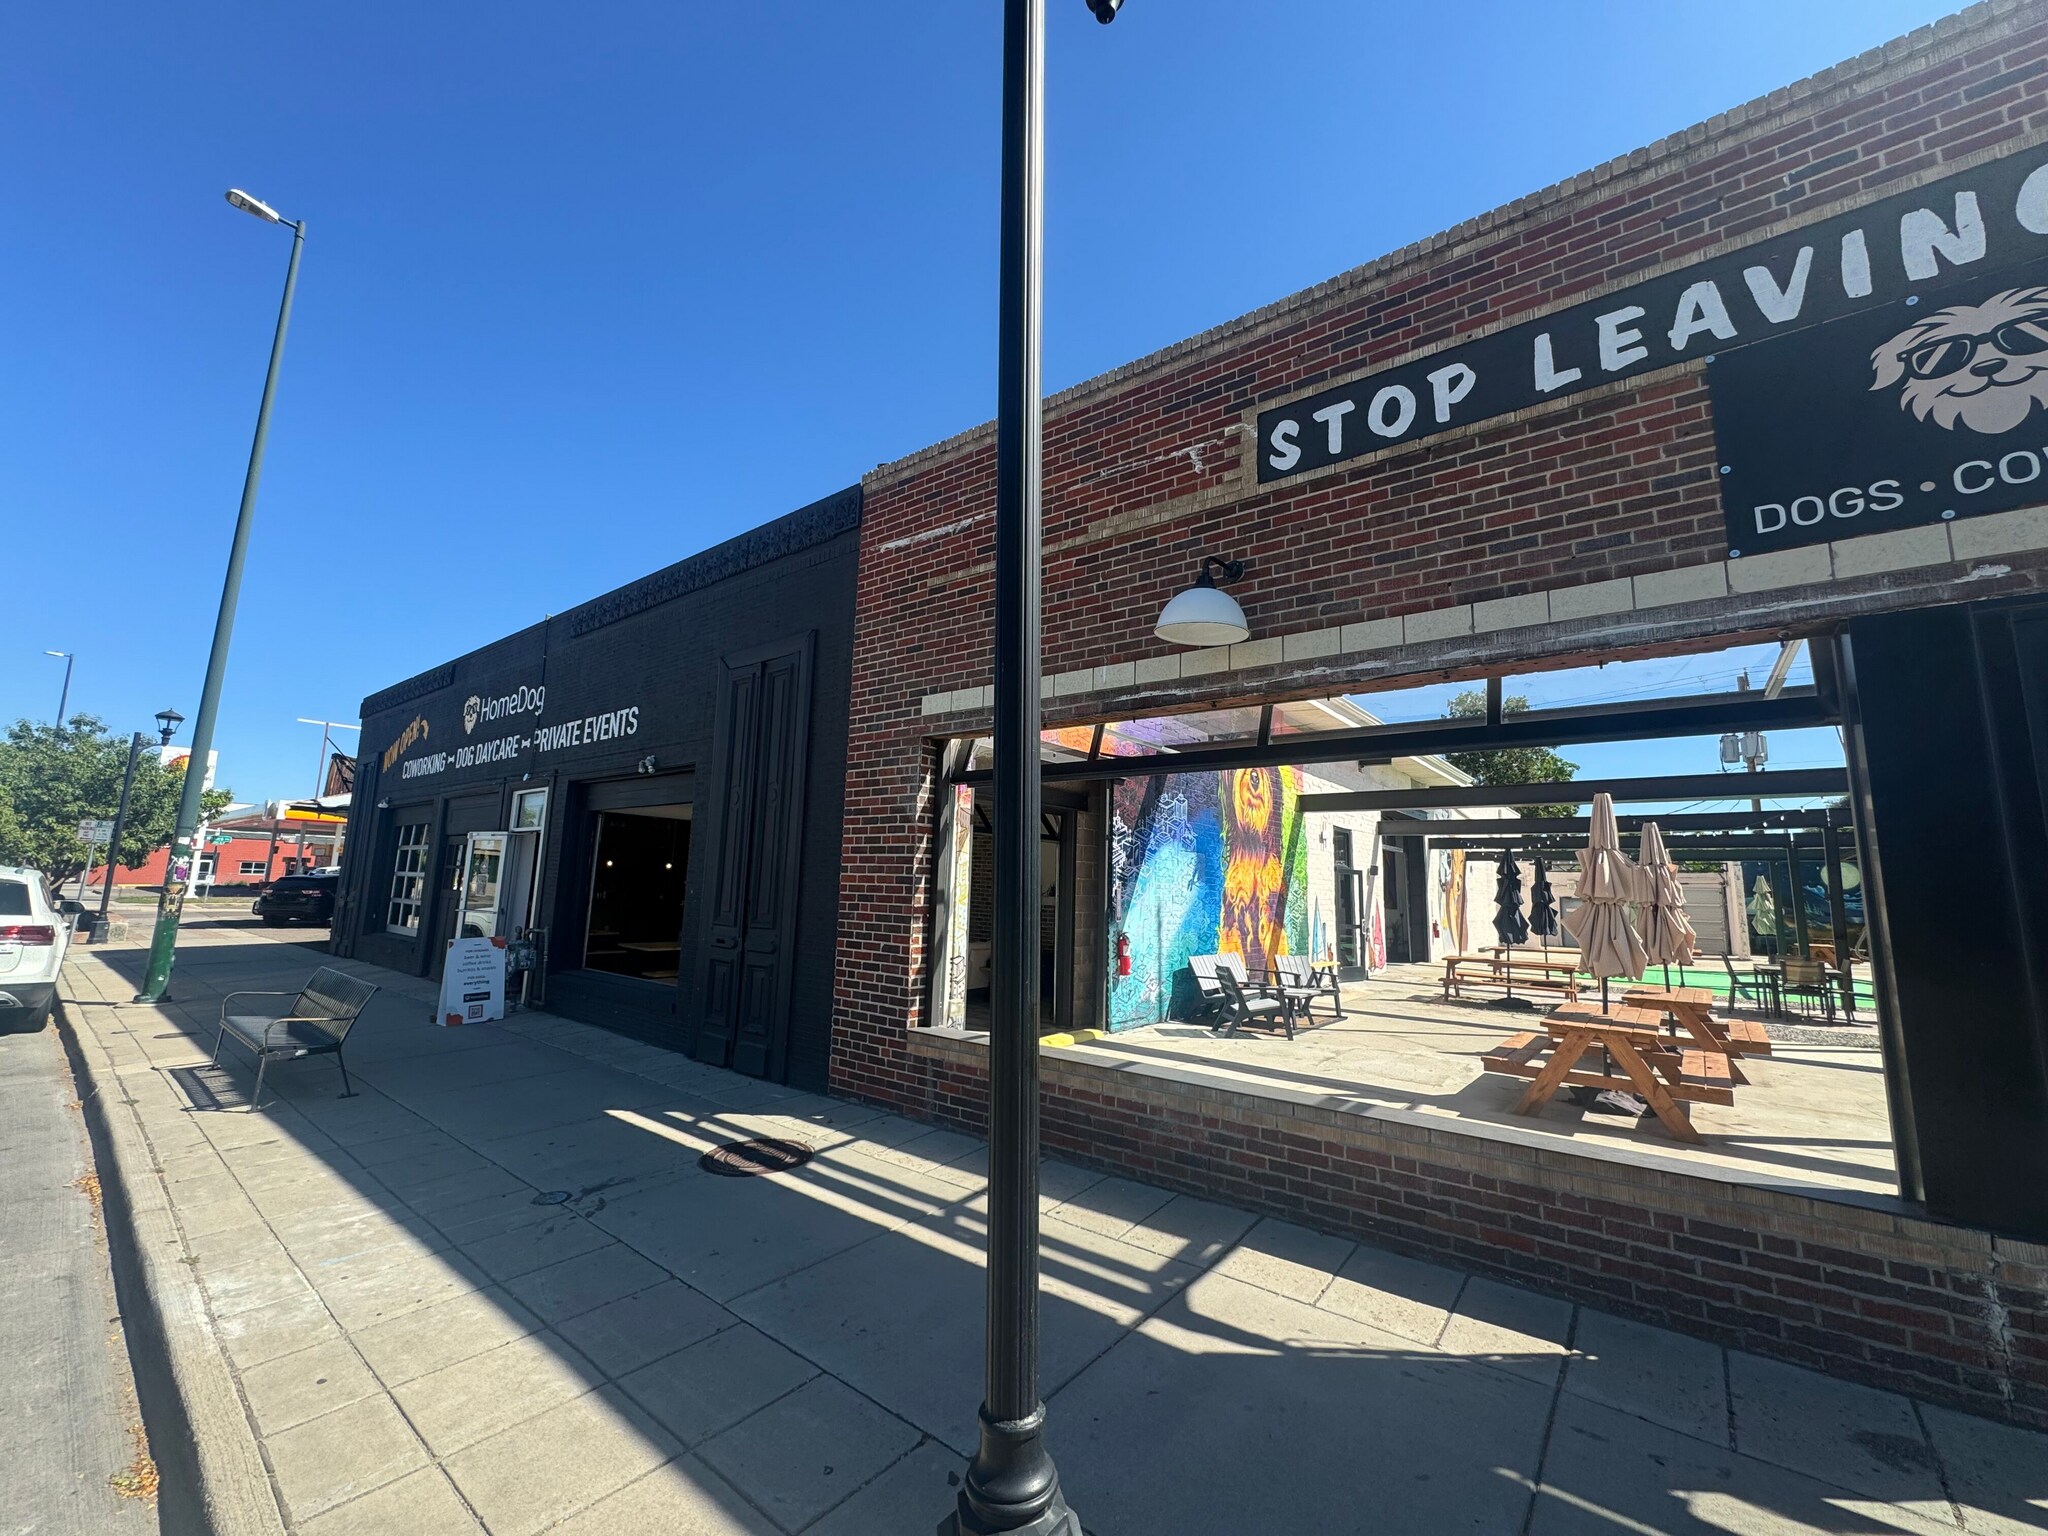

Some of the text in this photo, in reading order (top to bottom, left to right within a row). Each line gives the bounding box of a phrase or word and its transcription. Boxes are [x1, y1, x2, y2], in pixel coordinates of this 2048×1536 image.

[1268, 362, 1477, 471] STOP
[1753, 446, 2048, 534] DOGS CO
[480, 685, 546, 723] HomeDog
[382, 738, 401, 774] NOW
[402, 706, 640, 779] COWORKING DOG DAYCARE PRIVATE EVENTS
